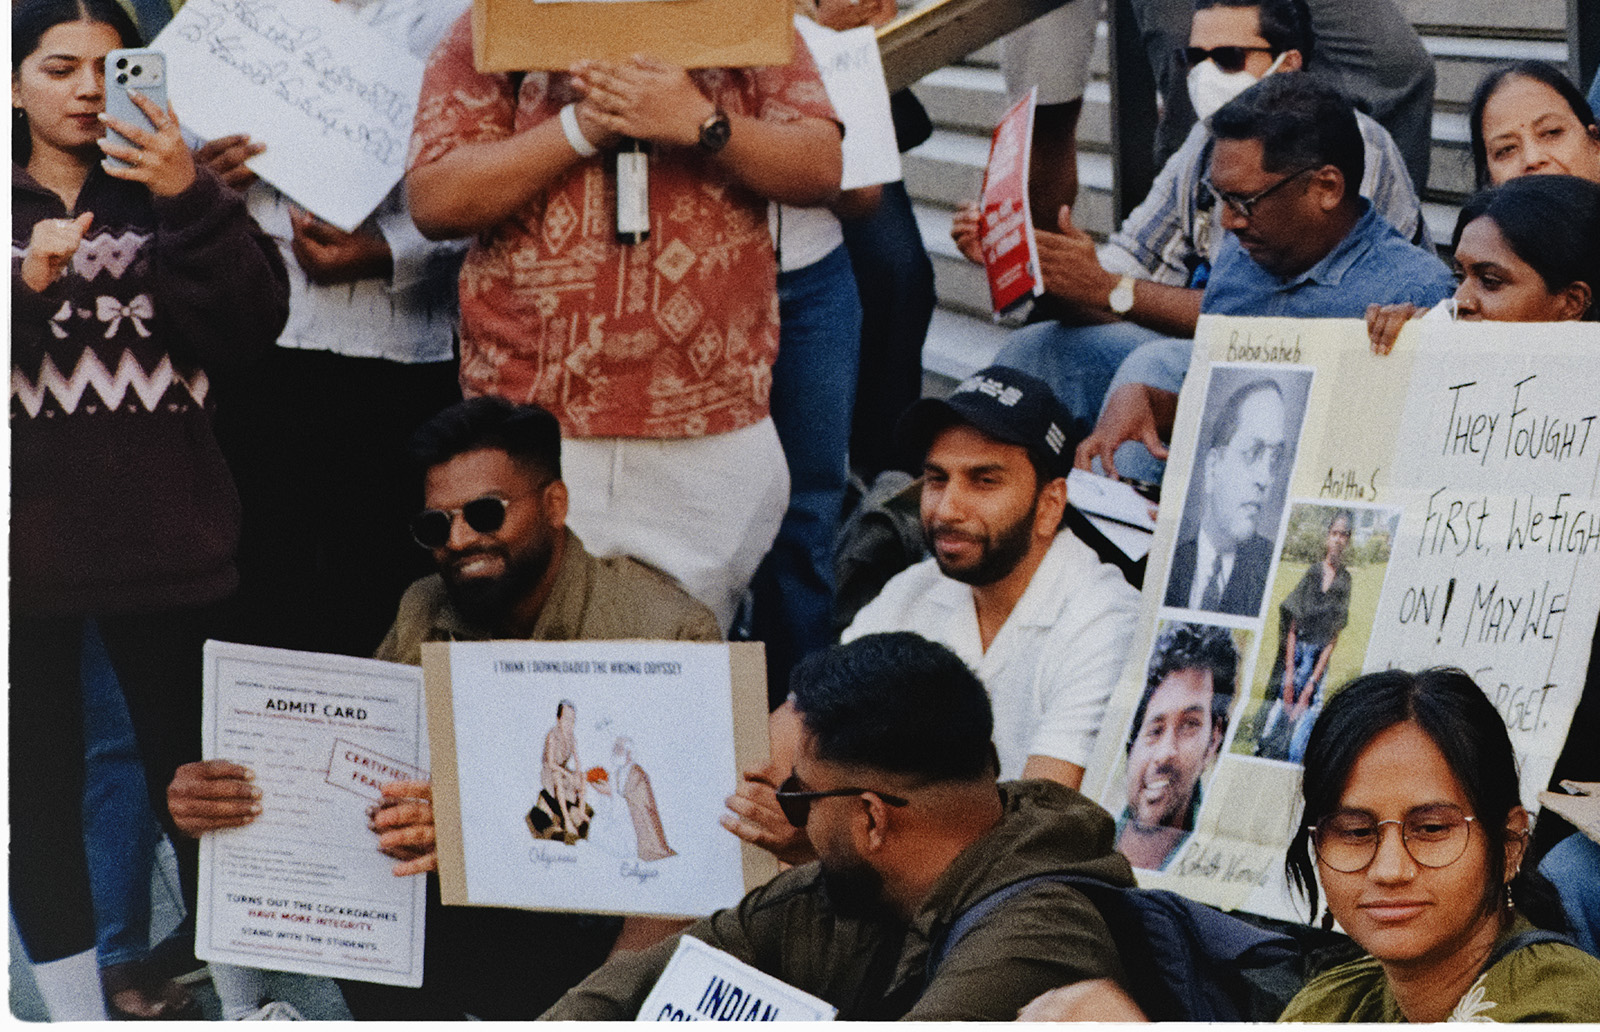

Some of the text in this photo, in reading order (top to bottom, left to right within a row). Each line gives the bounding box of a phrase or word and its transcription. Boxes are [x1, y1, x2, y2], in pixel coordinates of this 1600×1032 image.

[1400, 578, 1568, 648] ON! MAY WE
[266, 698, 368, 720] ADMIT CARD
[227, 893, 262, 906] TURNS
[267, 898, 289, 908] OUT
[293, 900, 313, 911] THE
